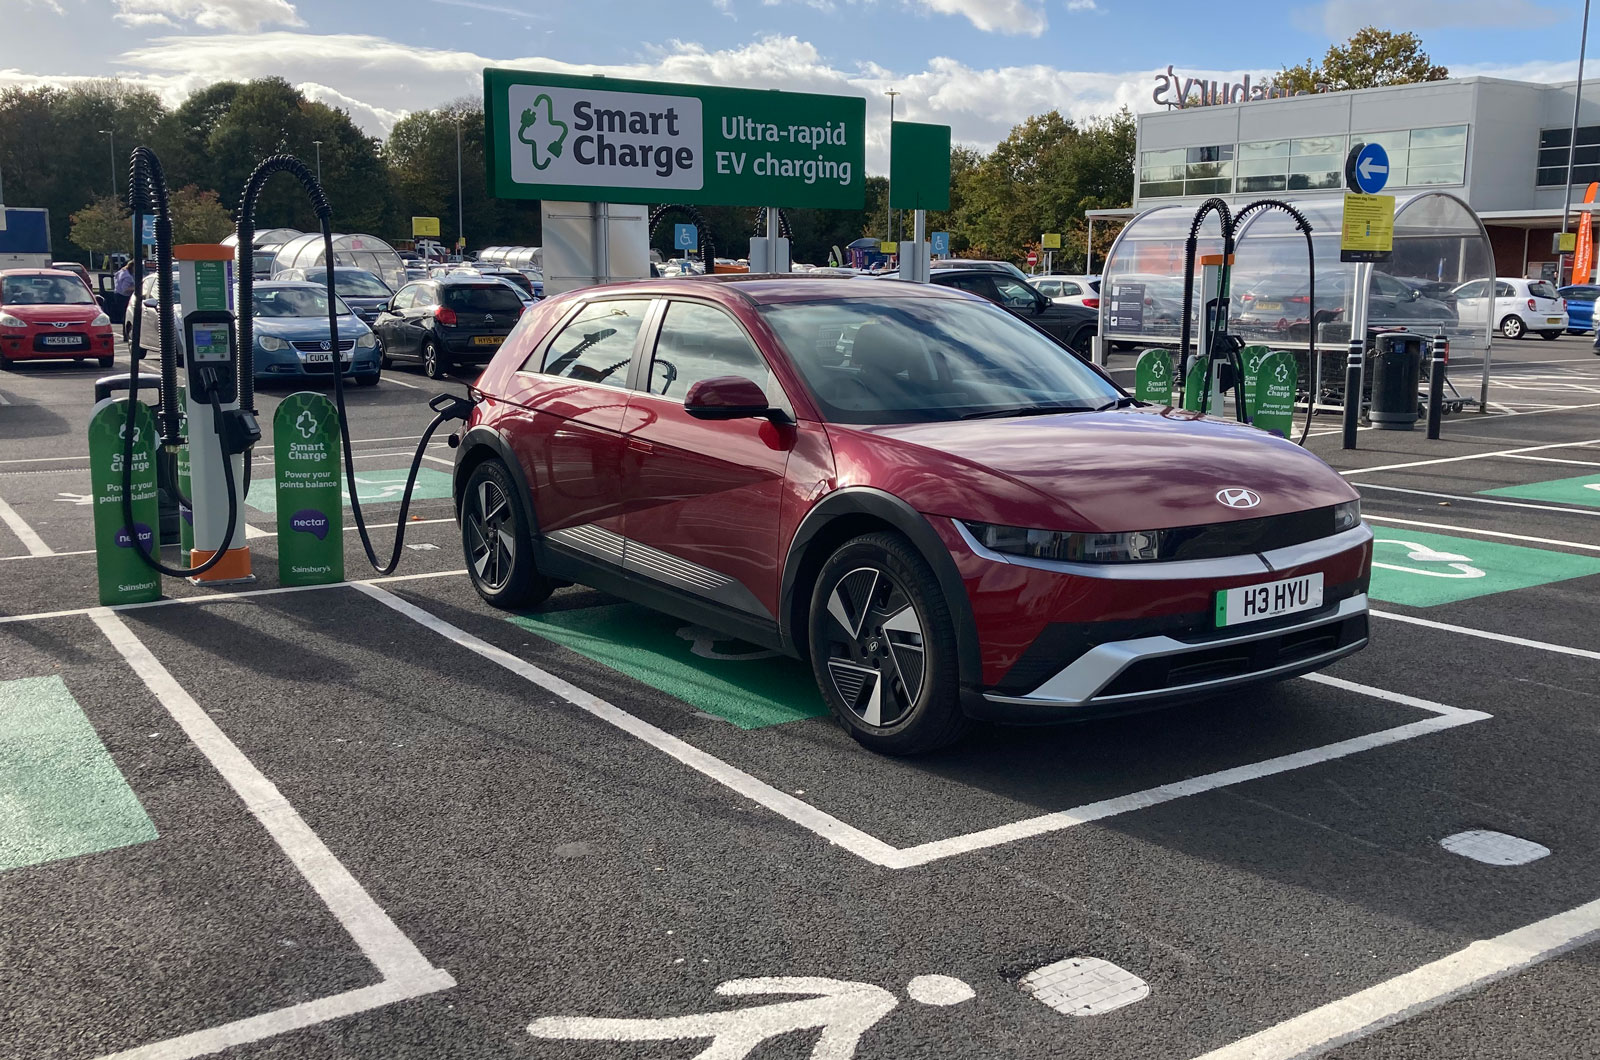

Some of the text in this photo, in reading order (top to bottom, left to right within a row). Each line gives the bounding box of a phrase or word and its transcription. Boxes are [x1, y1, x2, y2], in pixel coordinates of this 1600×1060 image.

[573, 100, 680, 136] Smart
[721, 115, 847, 150] Ultra-rapid
[573, 134, 694, 177] Charge
[715, 151, 852, 185] EV charging
[1267, 390, 1291, 398] Charge
[290, 442, 325, 452] Smart
[288, 451, 328, 461] Charge
[285, 470, 331, 480] Power your
[137, 481, 153, 491] your
[279, 480, 338, 489] points balance
[99, 494, 124, 504] point
[293, 518, 326, 527] nectar
[119, 532, 152, 542] netar
[291, 565, 331, 574] Sainsbury's
[1244, 579, 1310, 617] H3 HYU
